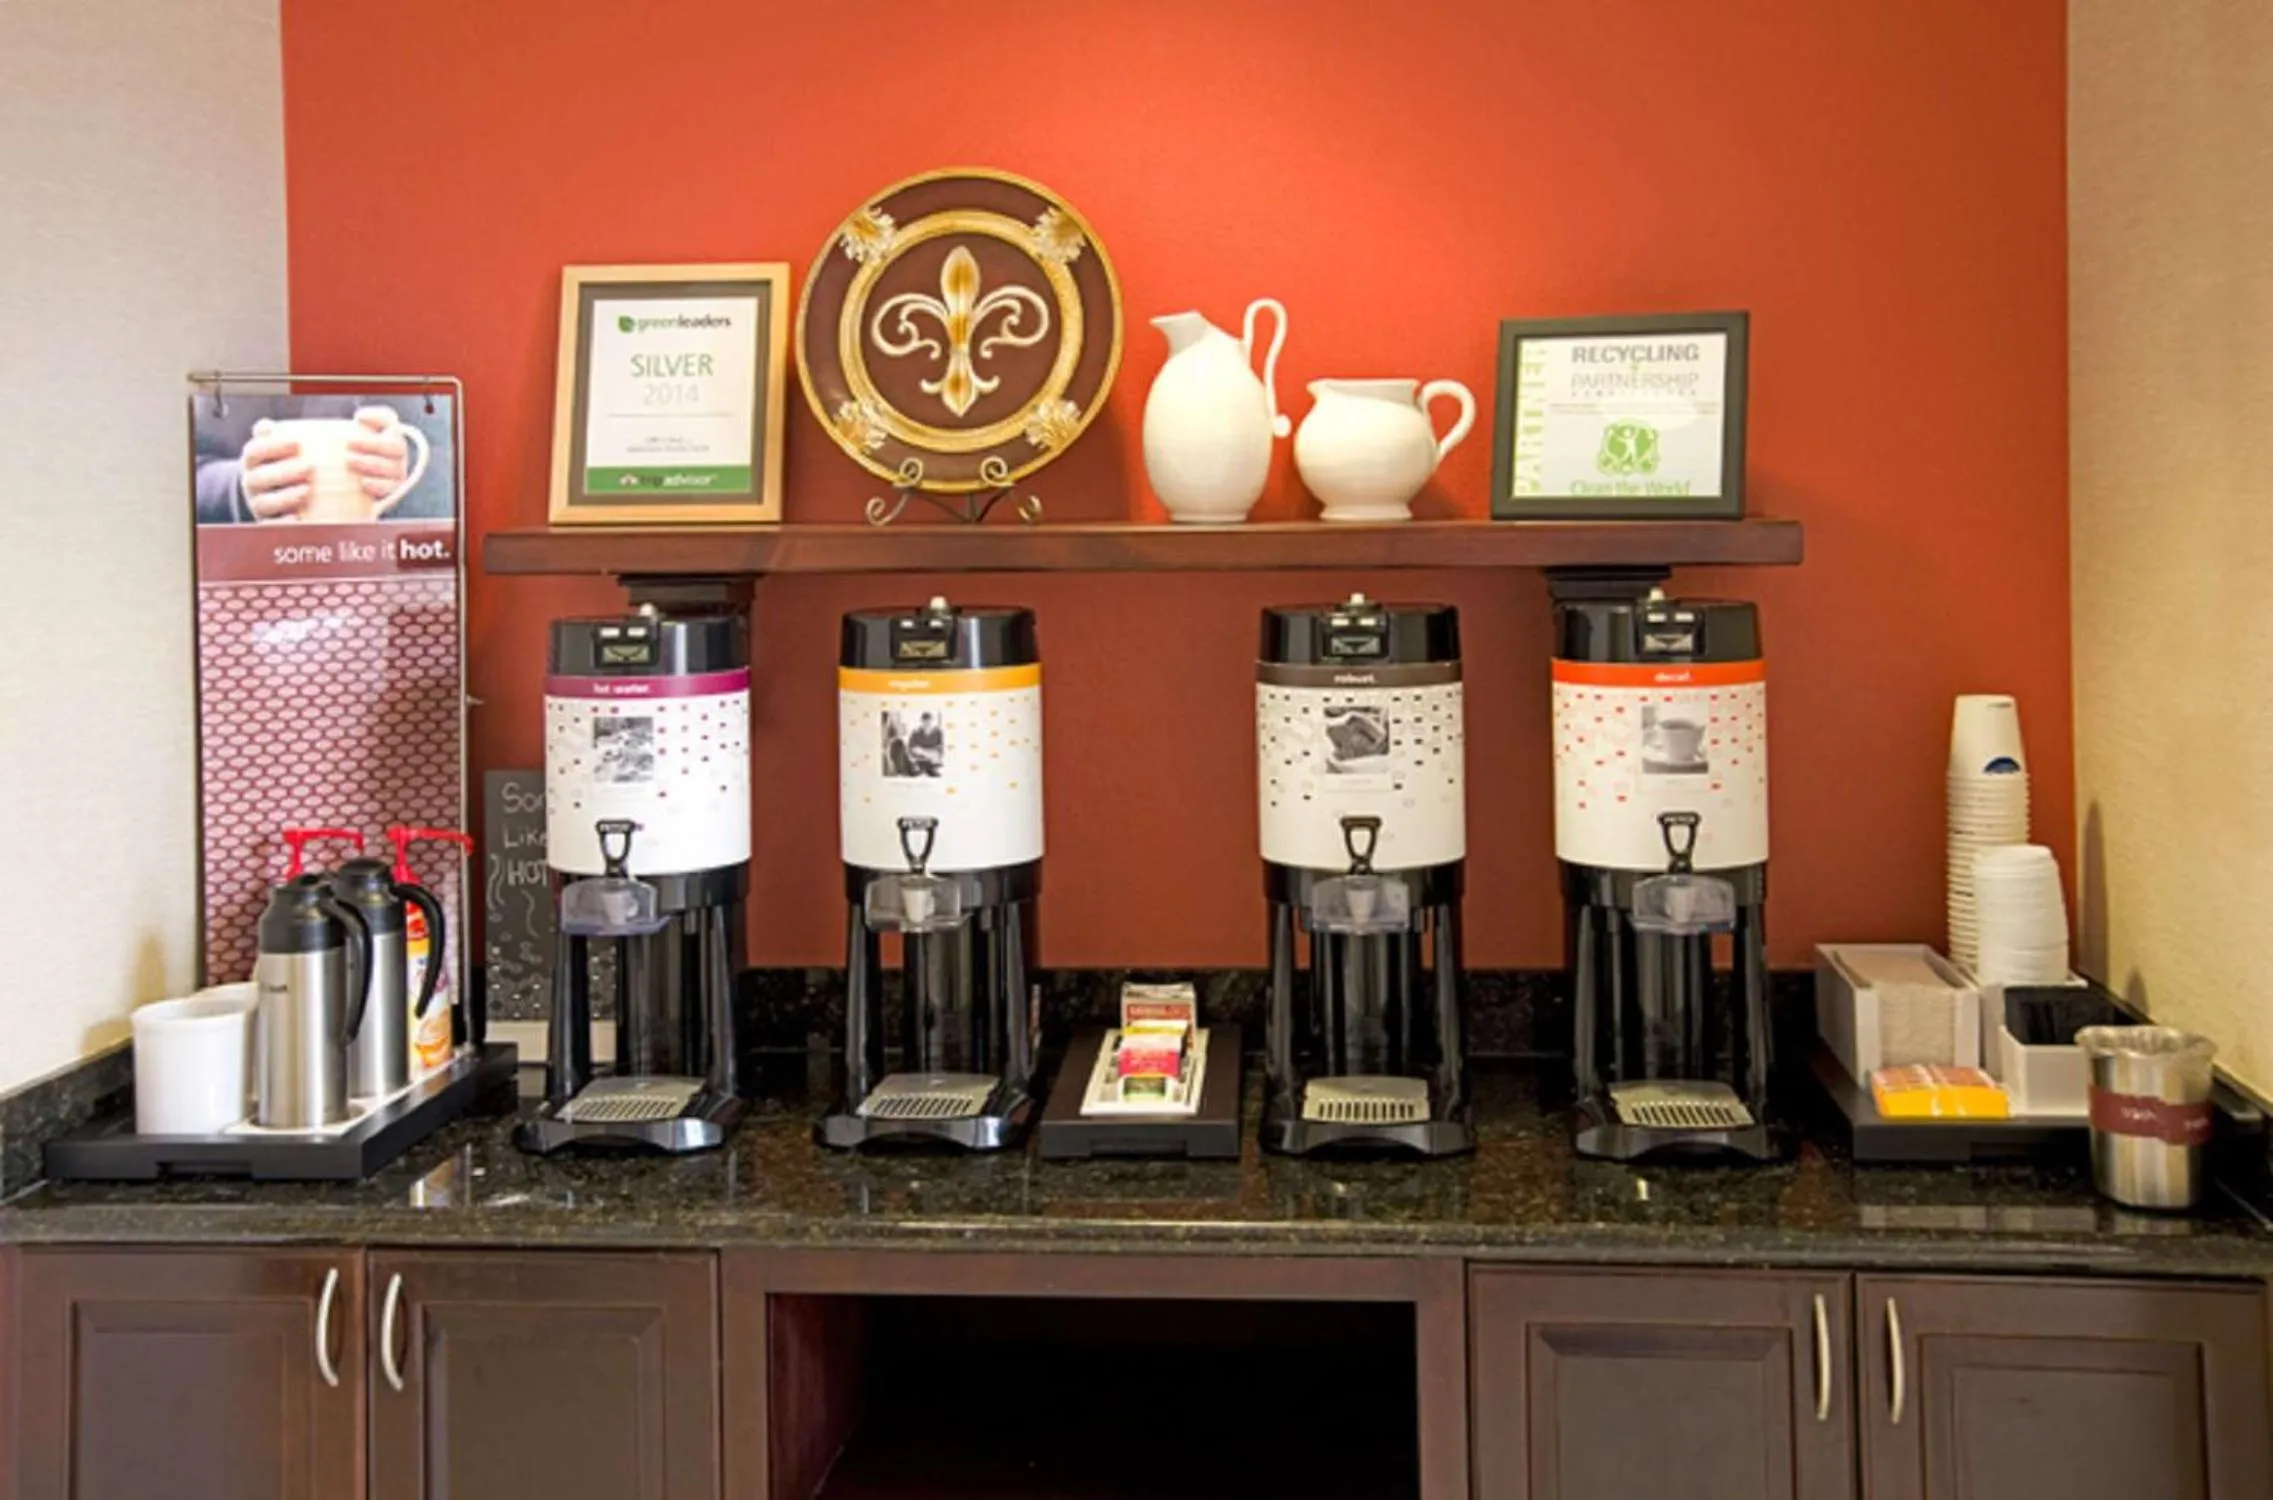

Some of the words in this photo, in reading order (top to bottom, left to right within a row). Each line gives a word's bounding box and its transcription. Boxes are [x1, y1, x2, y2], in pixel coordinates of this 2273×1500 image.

[637, 313, 732, 333] greenleaders
[1571, 343, 1700, 364] RECYCLING
[629, 353, 715, 378] SILVER
[1570, 371, 1700, 389] PARTNERSHIP
[642, 383, 701, 405] 2014
[273, 543, 333, 564] some
[337, 540, 376, 562] like
[380, 538, 397, 560] it
[400, 538, 451, 561] hot.
